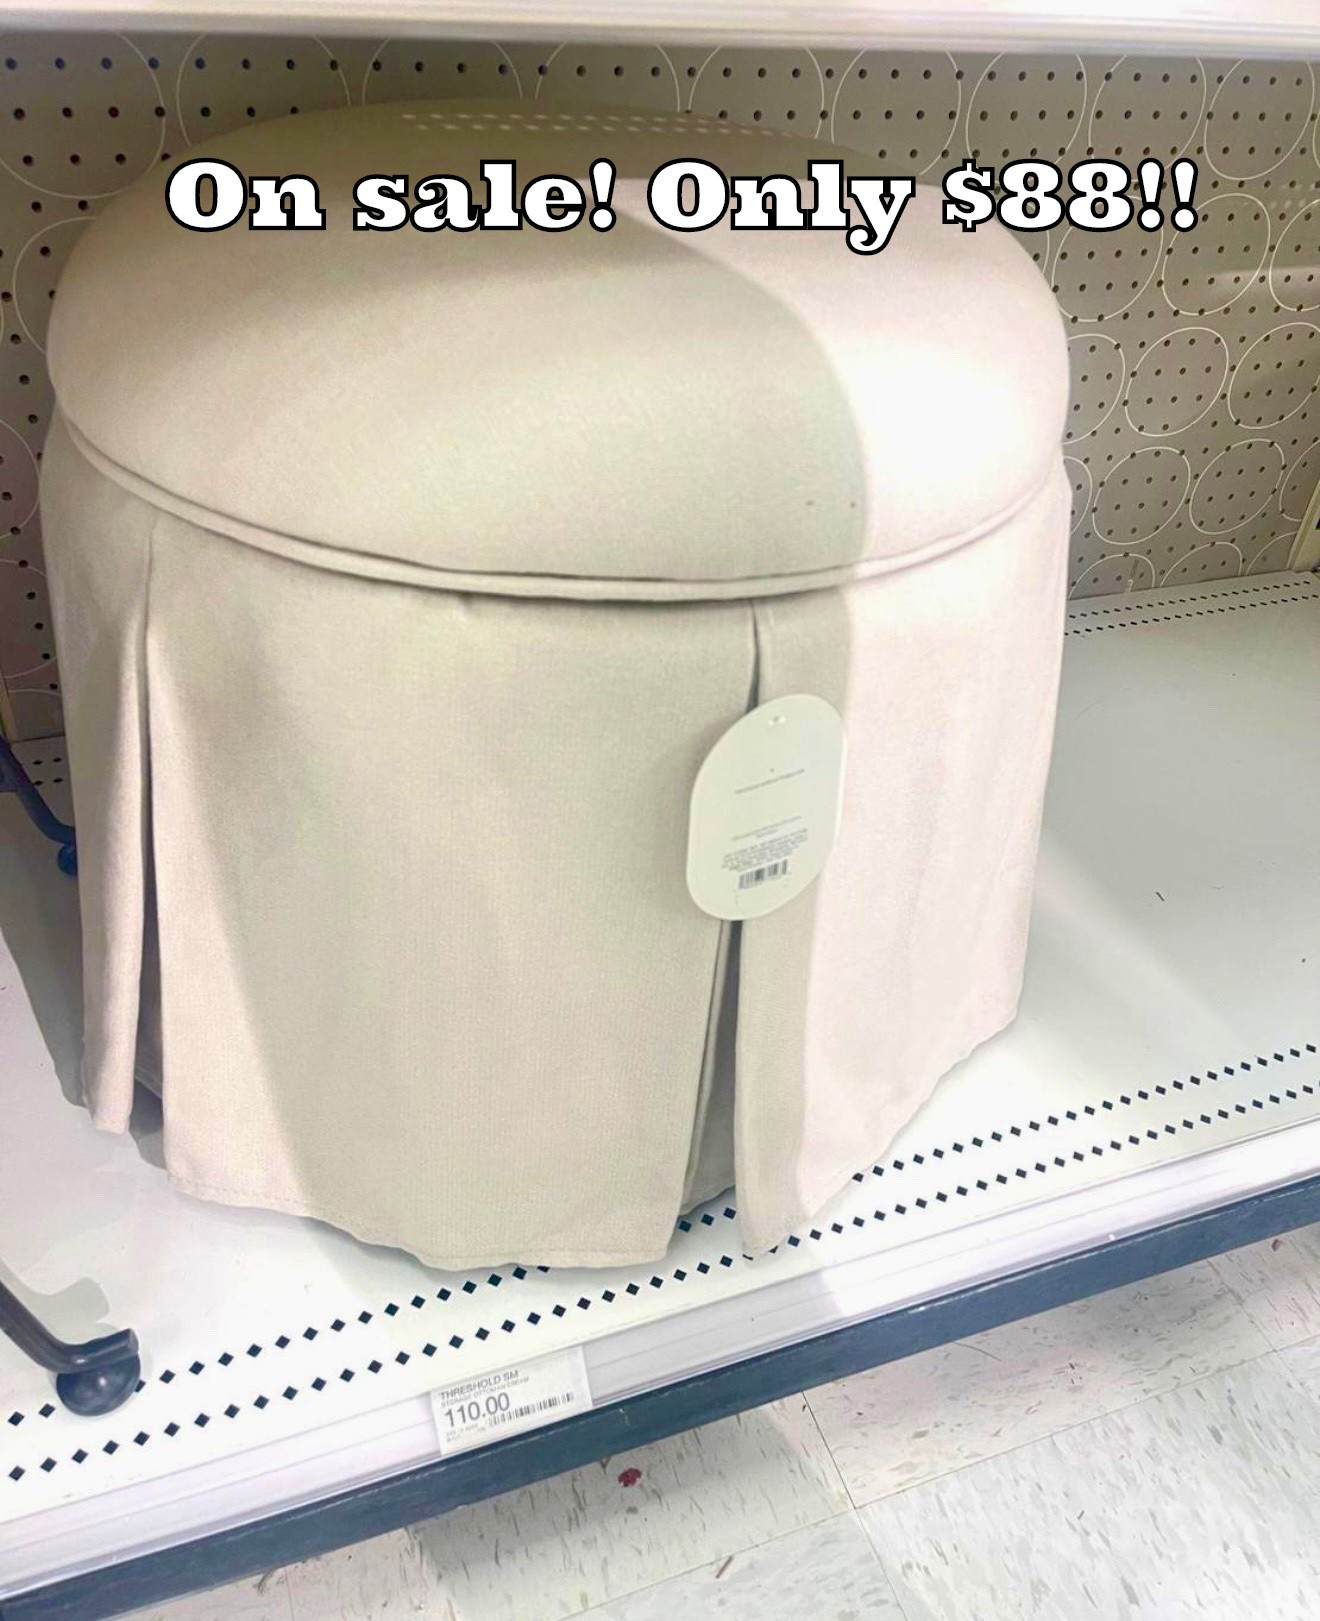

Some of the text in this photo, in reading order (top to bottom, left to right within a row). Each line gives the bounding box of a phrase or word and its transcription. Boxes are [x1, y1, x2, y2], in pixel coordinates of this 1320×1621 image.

[440, 1369, 519, 1400] THRESHOLD SM
[445, 1392, 510, 1427] 110.00
